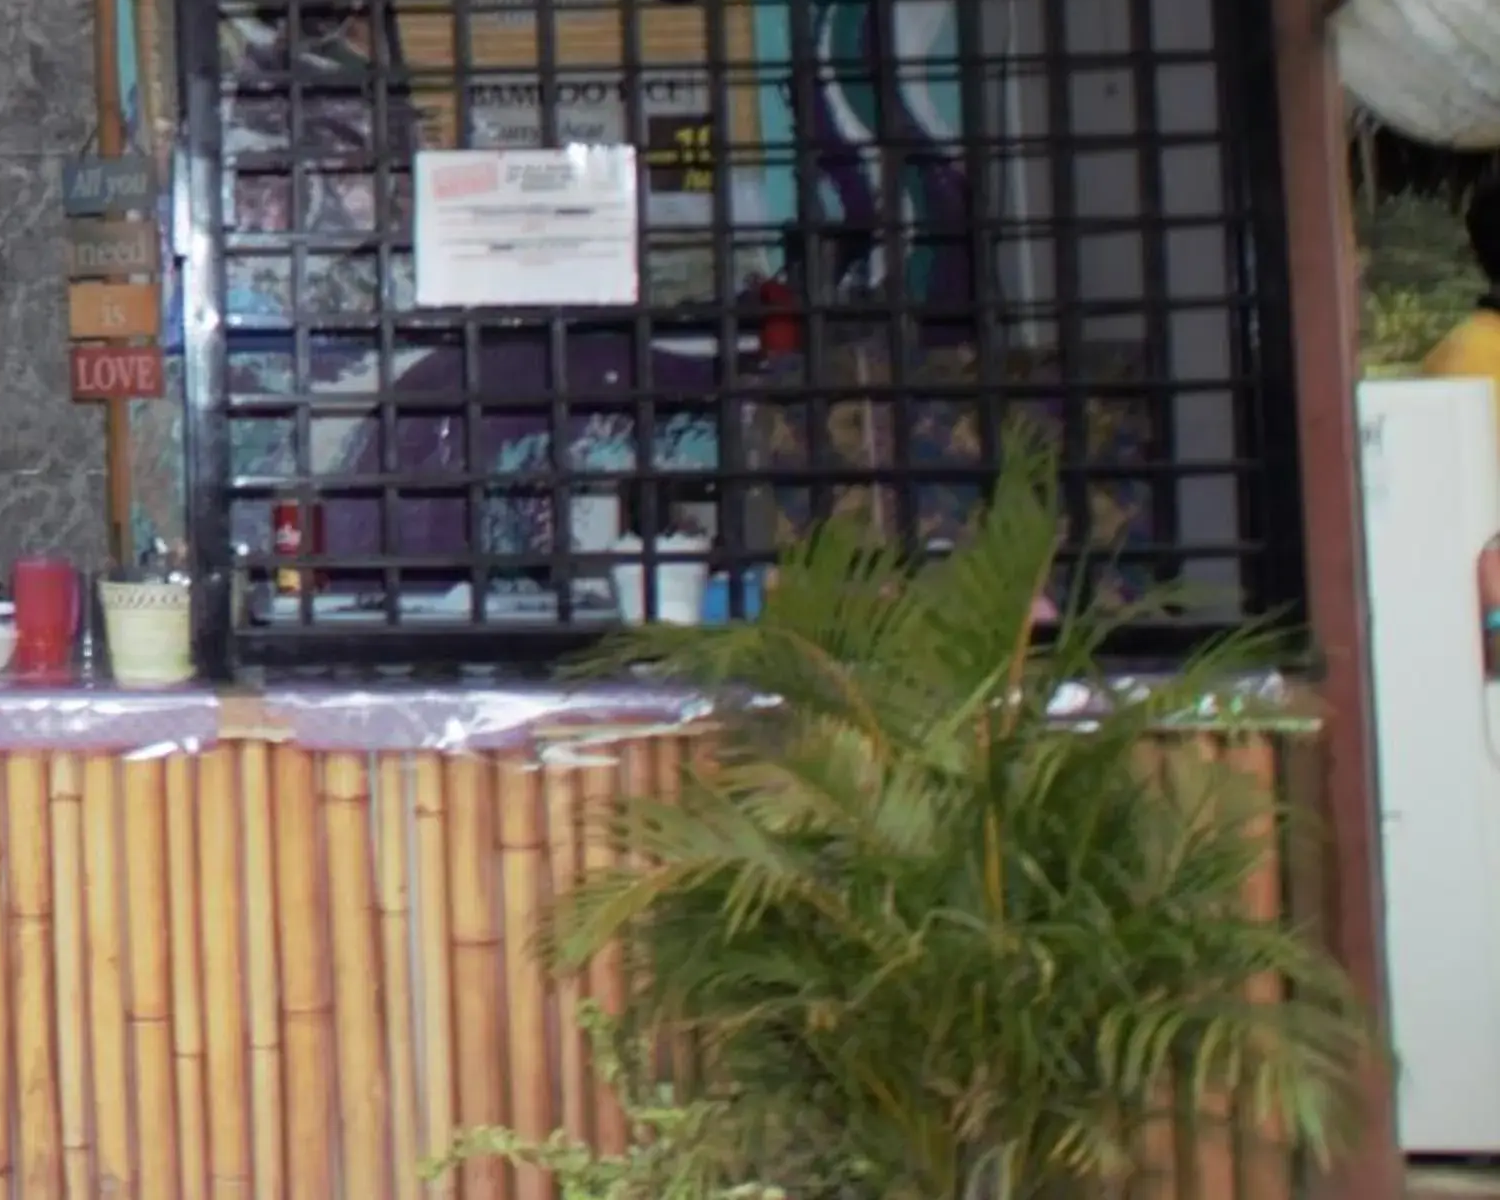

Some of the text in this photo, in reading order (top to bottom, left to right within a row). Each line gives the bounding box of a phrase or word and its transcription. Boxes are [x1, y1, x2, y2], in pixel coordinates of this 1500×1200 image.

[105, 173, 148, 208] you
[77, 230, 147, 266] need
[101, 299, 126, 326] is
[77, 355, 156, 392] LOVE
